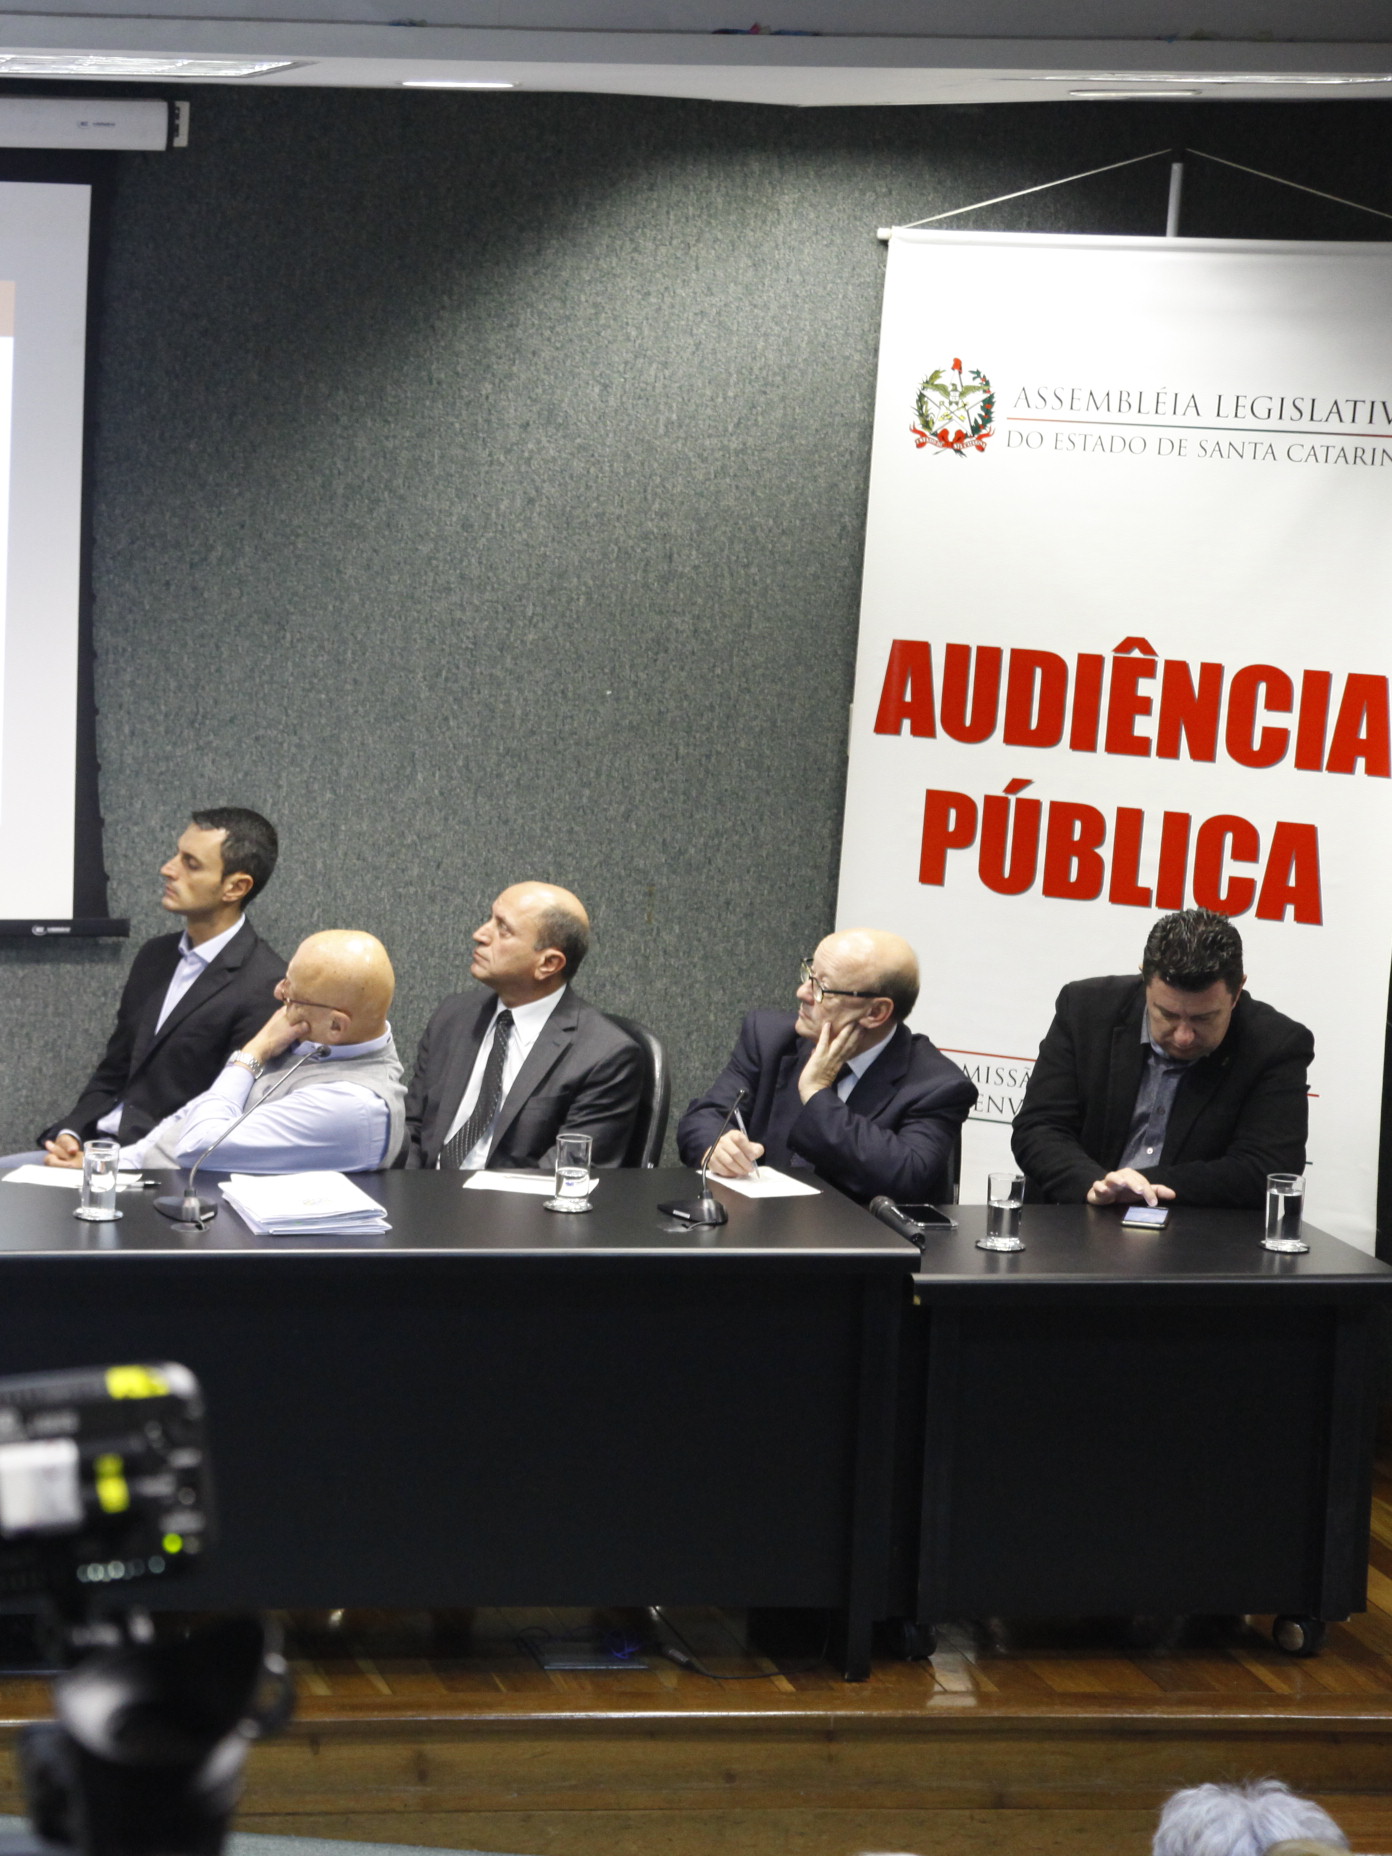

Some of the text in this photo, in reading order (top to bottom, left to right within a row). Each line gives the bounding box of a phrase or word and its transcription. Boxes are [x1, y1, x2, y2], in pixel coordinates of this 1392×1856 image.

[1013, 386, 1202, 417] ASSEMBLÉIA
[1007, 430, 1044, 449] DO
[1054, 431, 1147, 455] ESTADO
[1157, 437, 1188, 457] DE
[1197, 440, 1277, 461] SANTA
[873, 636, 1392, 778] AUDIÊNCIA
[918, 778, 1323, 926] PÚBLICA
